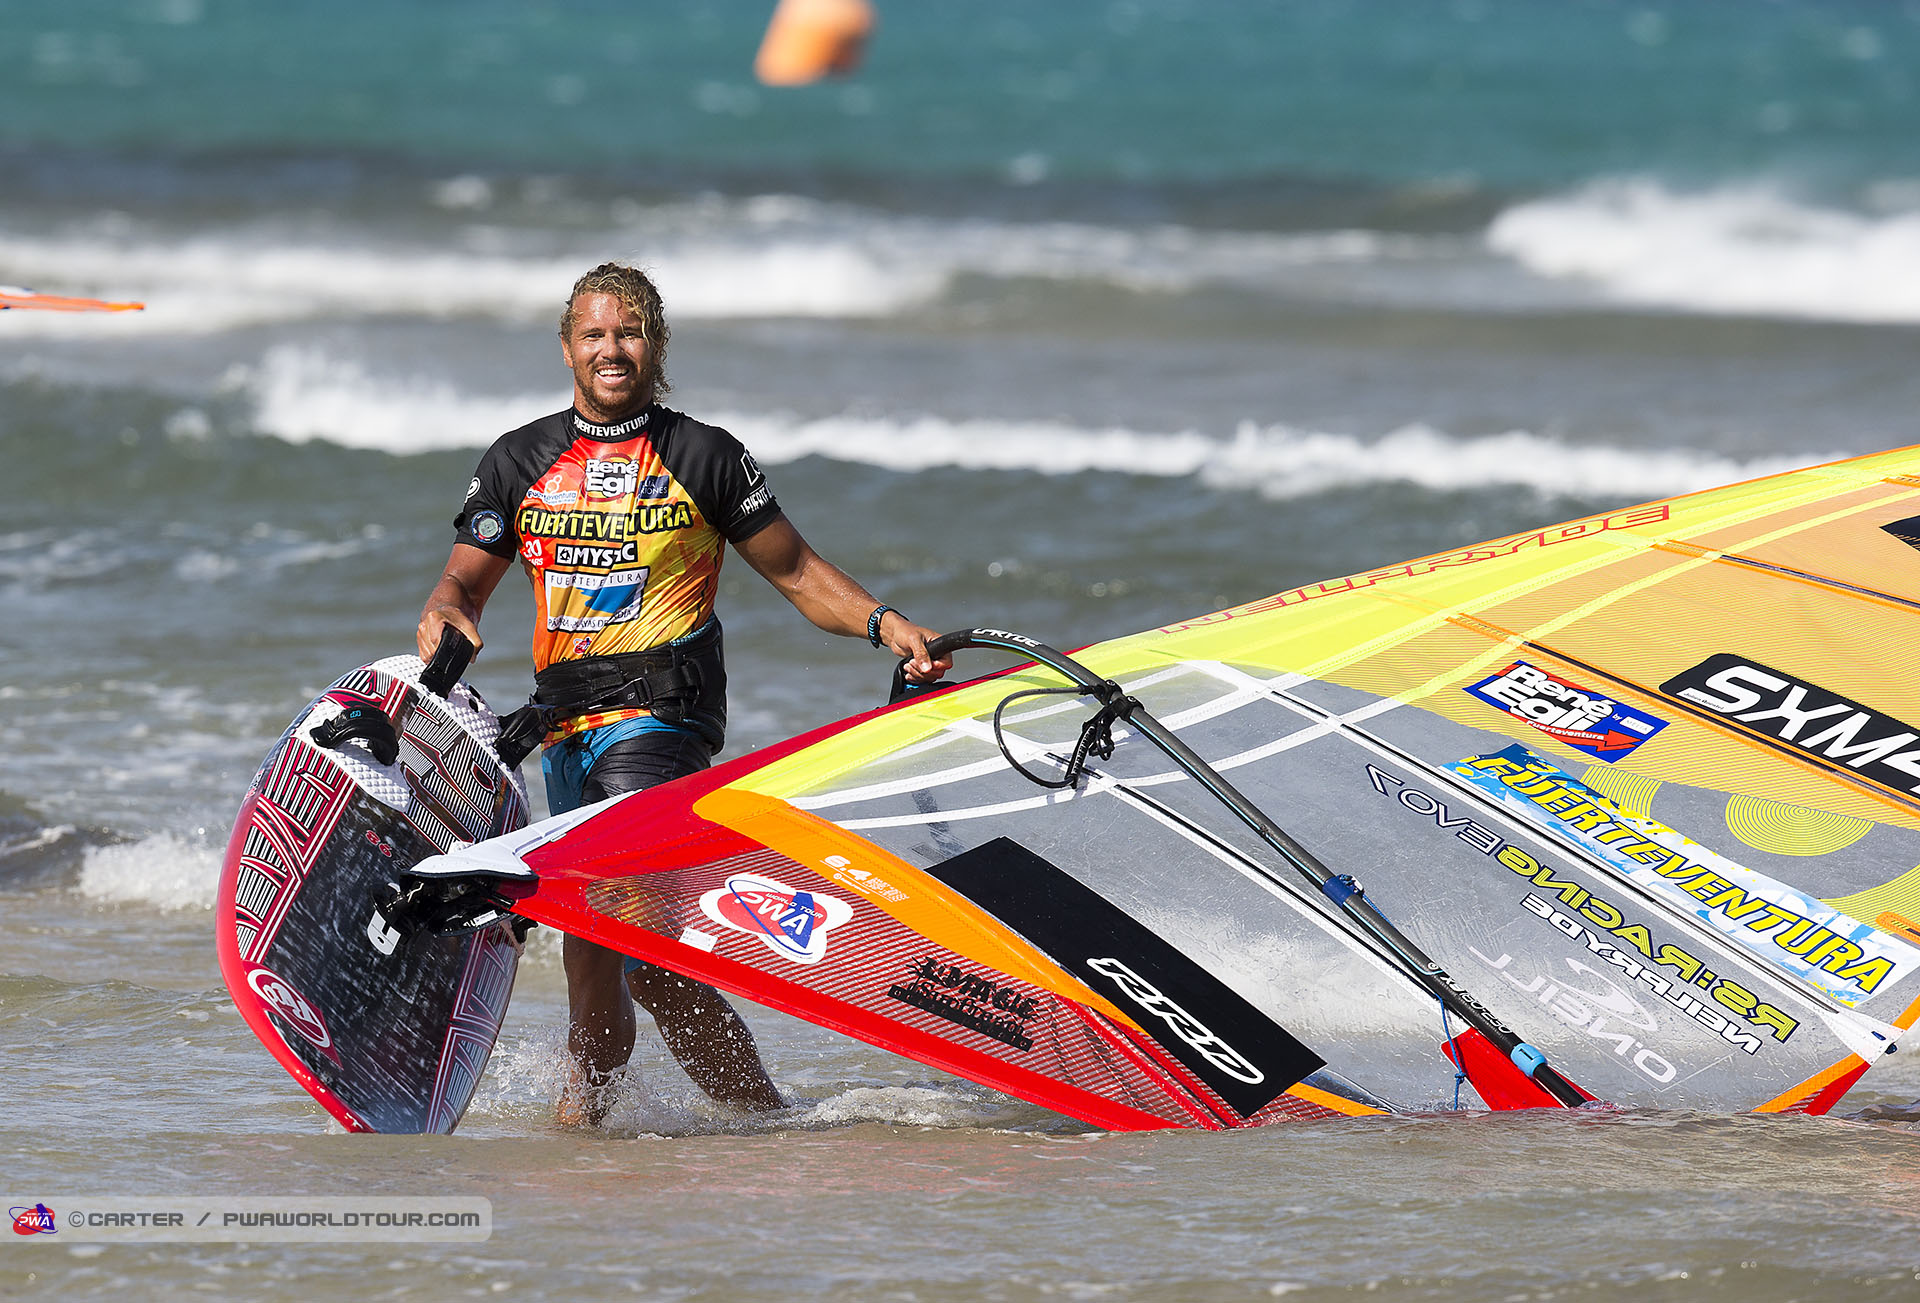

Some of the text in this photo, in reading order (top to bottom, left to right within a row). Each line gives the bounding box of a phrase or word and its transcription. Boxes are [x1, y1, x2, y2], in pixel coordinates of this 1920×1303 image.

[586, 459, 640, 475] René
[586, 472, 638, 498] Egli
[1160, 504, 1669, 635] NEILPRYDE
[1478, 676, 1602, 732] Egli
[1612, 712, 1623, 722] by
[1506, 664, 1617, 718] René
[824, 855, 873, 882] 6.4
[1467, 755, 1896, 995] FUERTEVENTURA
[735, 892, 810, 936] PWA
[765, 893, 824, 919] WORLD TOUR
